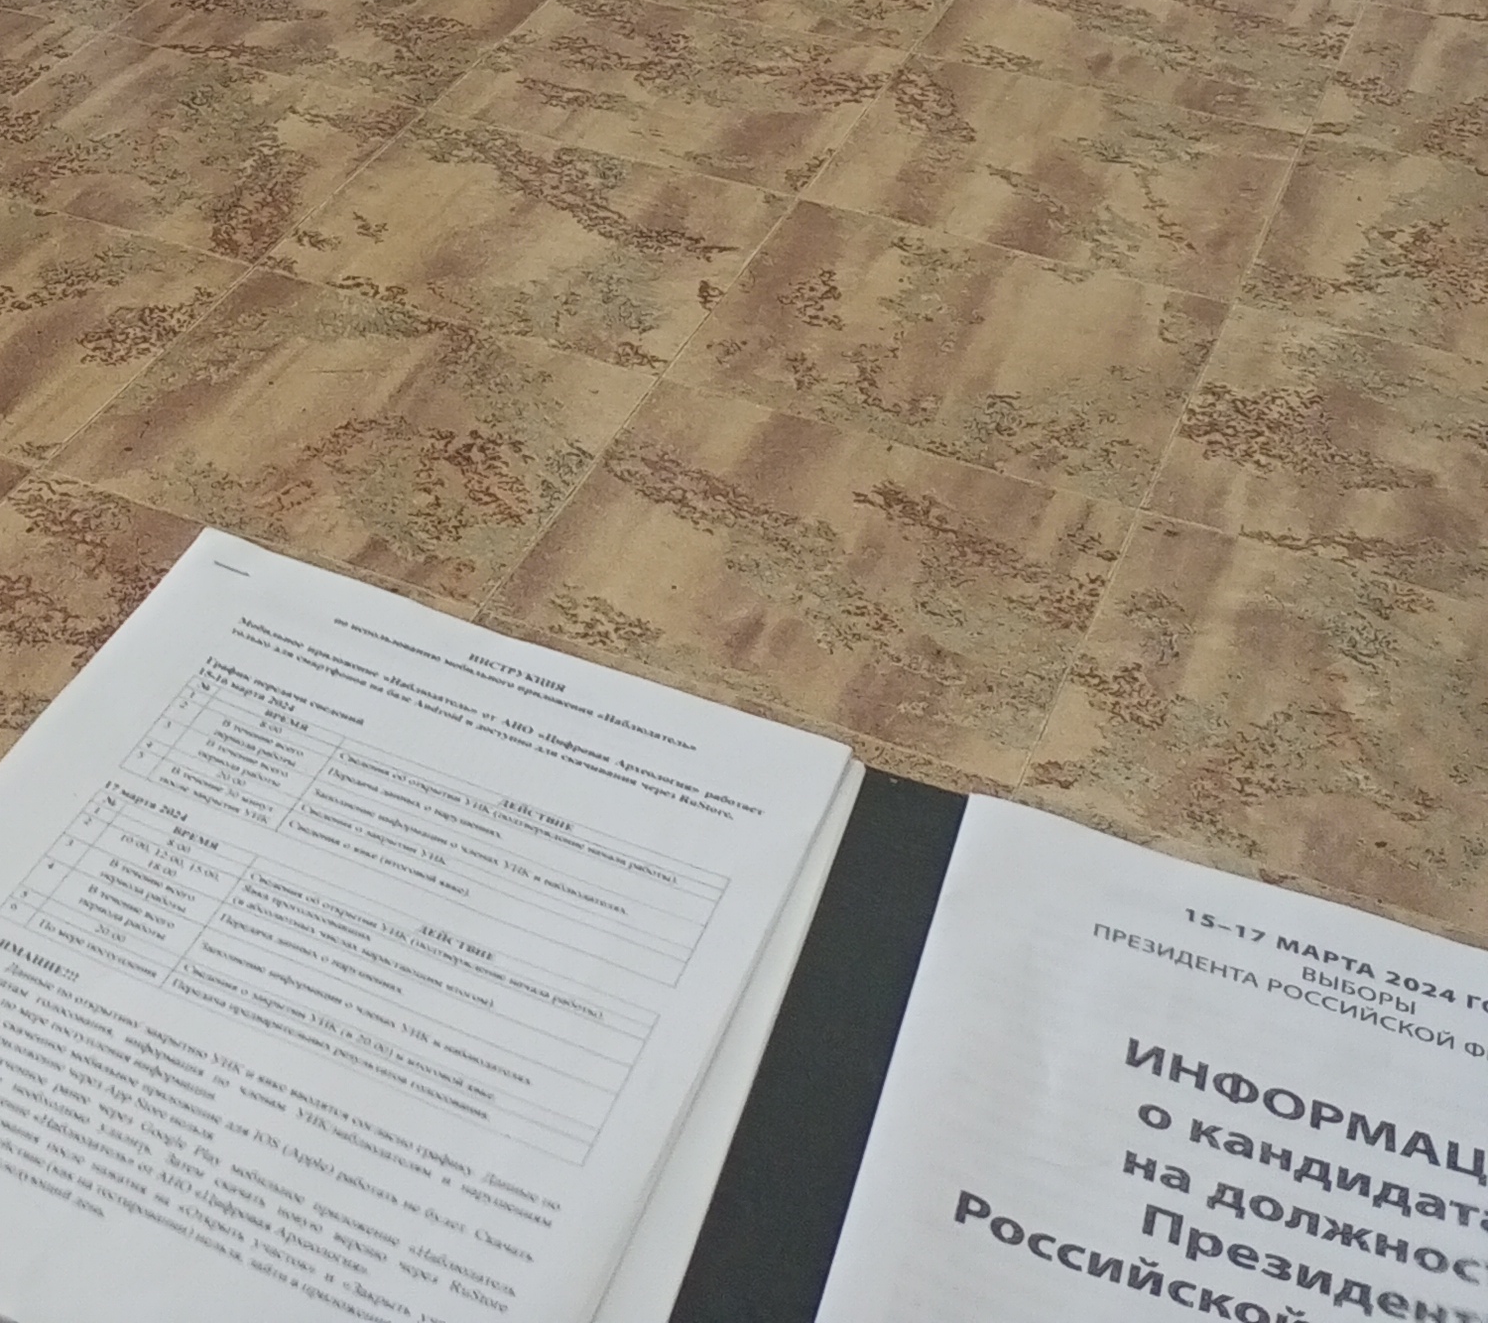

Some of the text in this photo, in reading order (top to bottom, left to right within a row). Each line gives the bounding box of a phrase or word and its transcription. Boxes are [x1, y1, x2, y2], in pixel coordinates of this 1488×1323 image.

[1093, 923, 1455, 1050] ПРЕЗИДЕНТА РОССИЙСКОЙ
[1276, 935, 1376, 979] МАРТА
[1385, 970, 1457, 1004] 2024
[1301, 966, 1416, 1015] ВЫБОРЫ
[1137, 1103, 1173, 1131] о
[1122, 1149, 1488, 1285] на должнос
